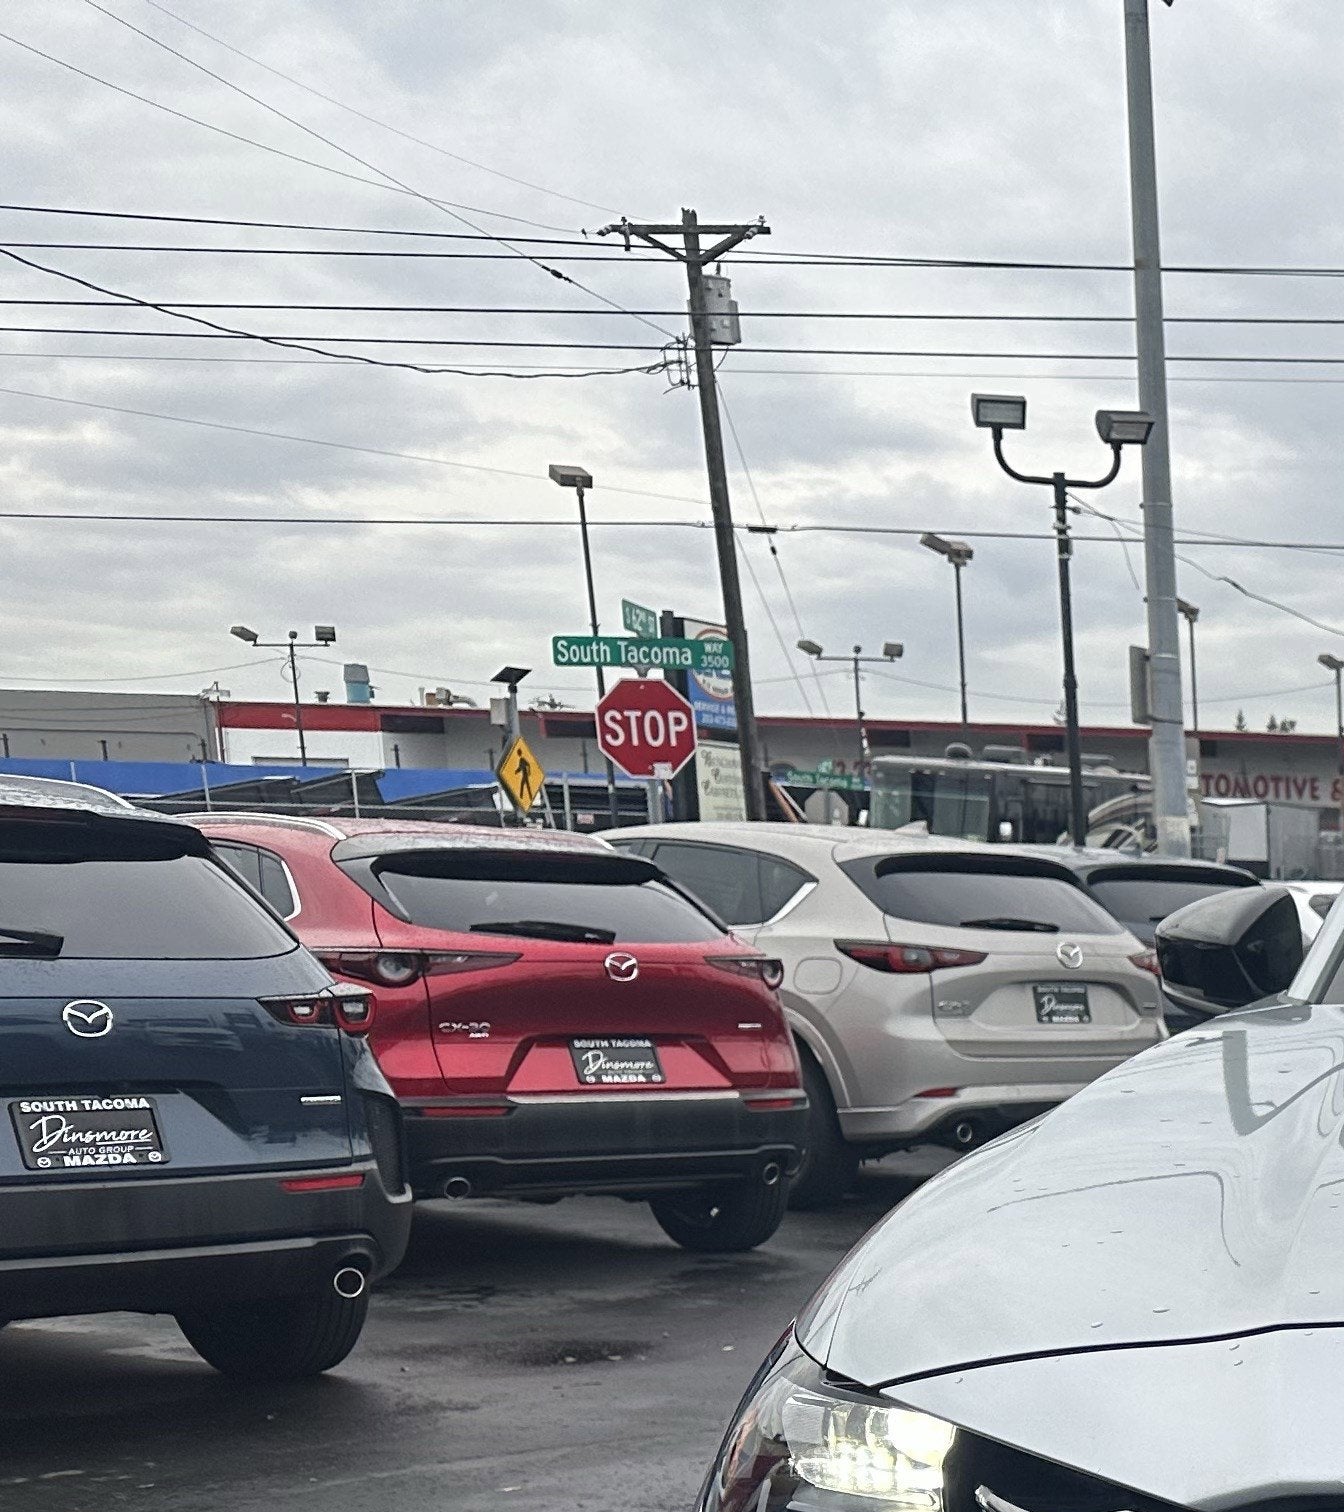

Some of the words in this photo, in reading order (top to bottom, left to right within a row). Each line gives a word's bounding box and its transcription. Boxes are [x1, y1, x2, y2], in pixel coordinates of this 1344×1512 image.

[556, 640, 610, 663] South
[617, 640, 692, 665] Tacoma
[703, 642, 723, 653] WAY
[700, 655, 729, 668] 3500
[604, 709, 689, 747] STOP
[573, 1039, 609, 1048] SOUTH
[610, 1039, 652, 1048] TACOMA
[582, 1049, 655, 1075] Dinsmore
[601, 1074, 647, 1083] MAZDA
[20, 1100, 78, 1112] SOUTH
[81, 1097, 150, 1111] TACOMA
[29, 1114, 153, 1153] Dinsmore
[68, 1147, 96, 1155] AUTO
[98, 1145, 134, 1154] GROUP
[63, 1152, 137, 1167] MAZDA
